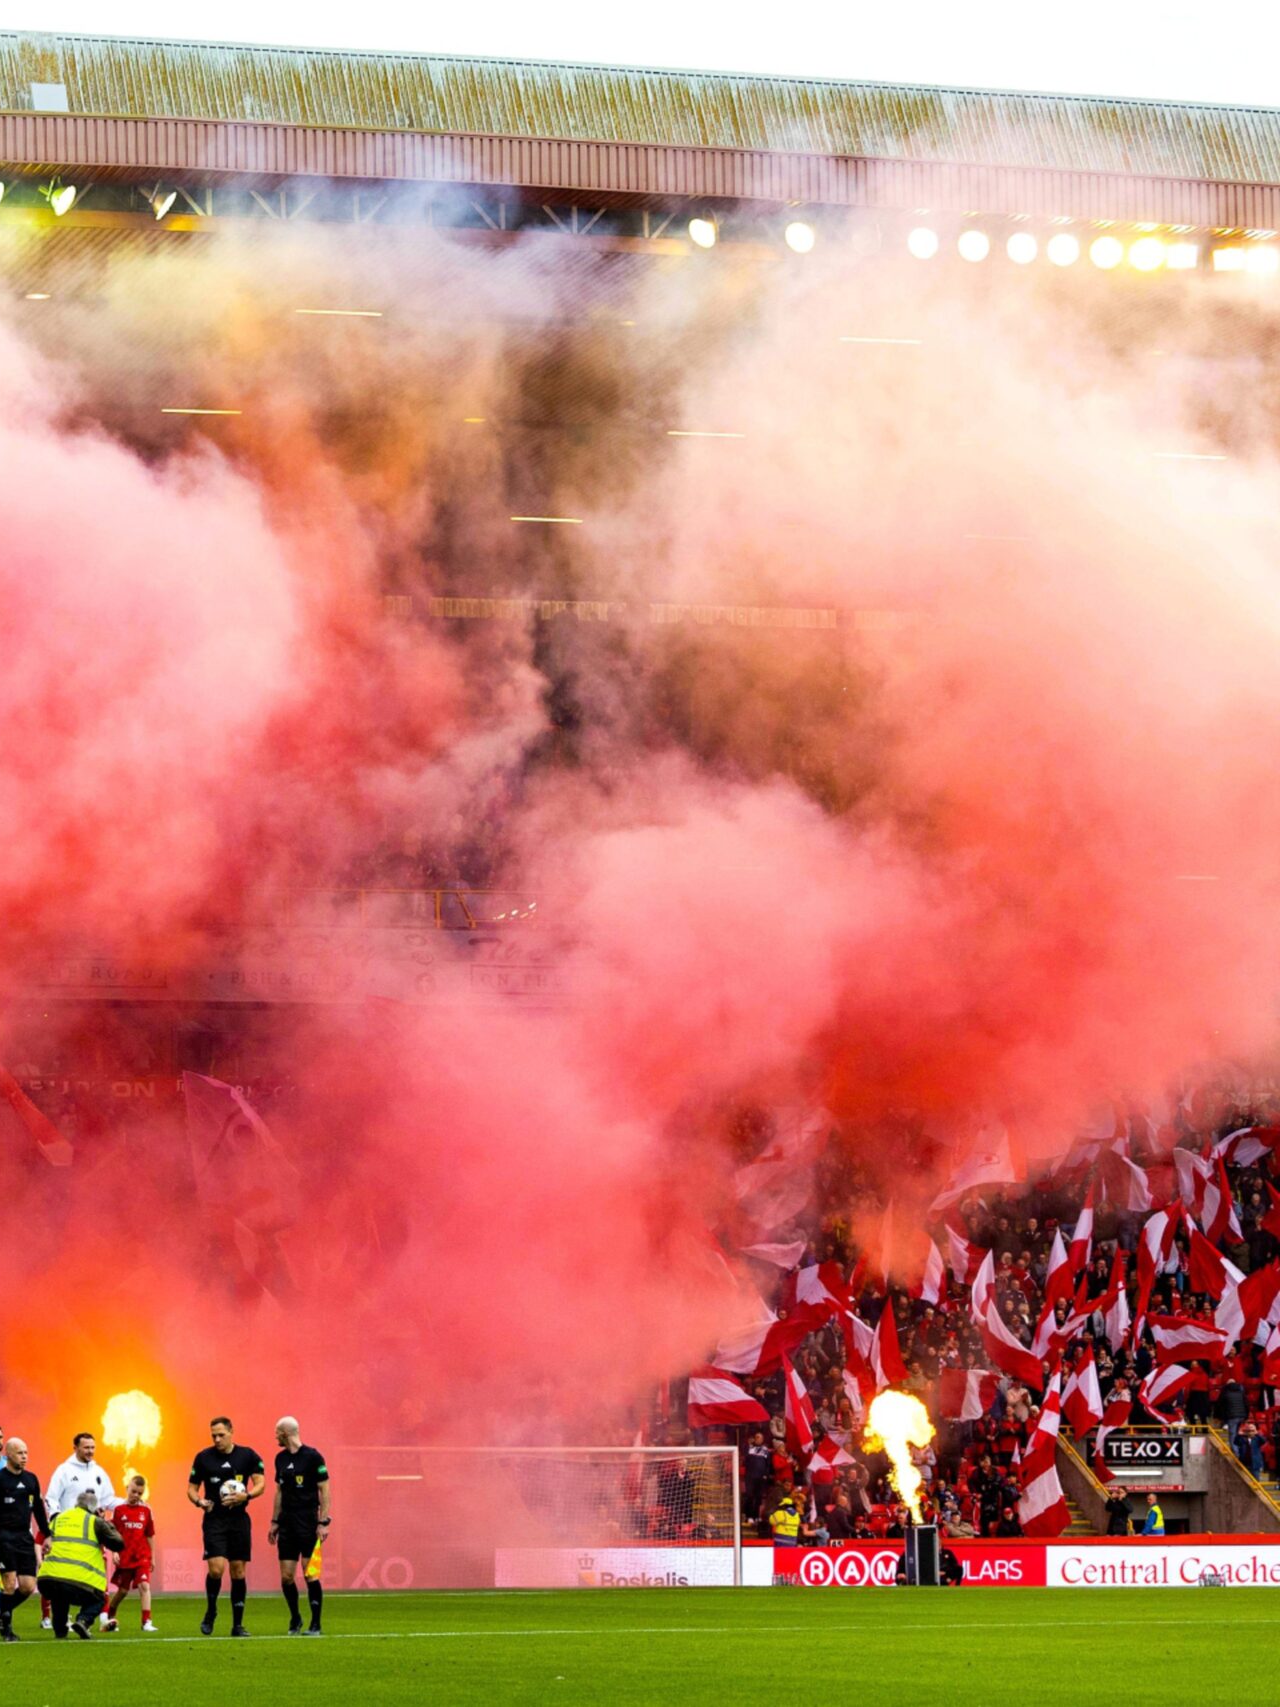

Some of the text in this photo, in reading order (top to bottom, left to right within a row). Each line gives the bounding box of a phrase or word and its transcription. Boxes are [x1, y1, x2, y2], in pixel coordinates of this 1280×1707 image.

[1107, 1441, 1162, 1458] TEXO
[1060, 1556, 1170, 1584] Central
[600, 1572, 690, 1587] Boskalis
